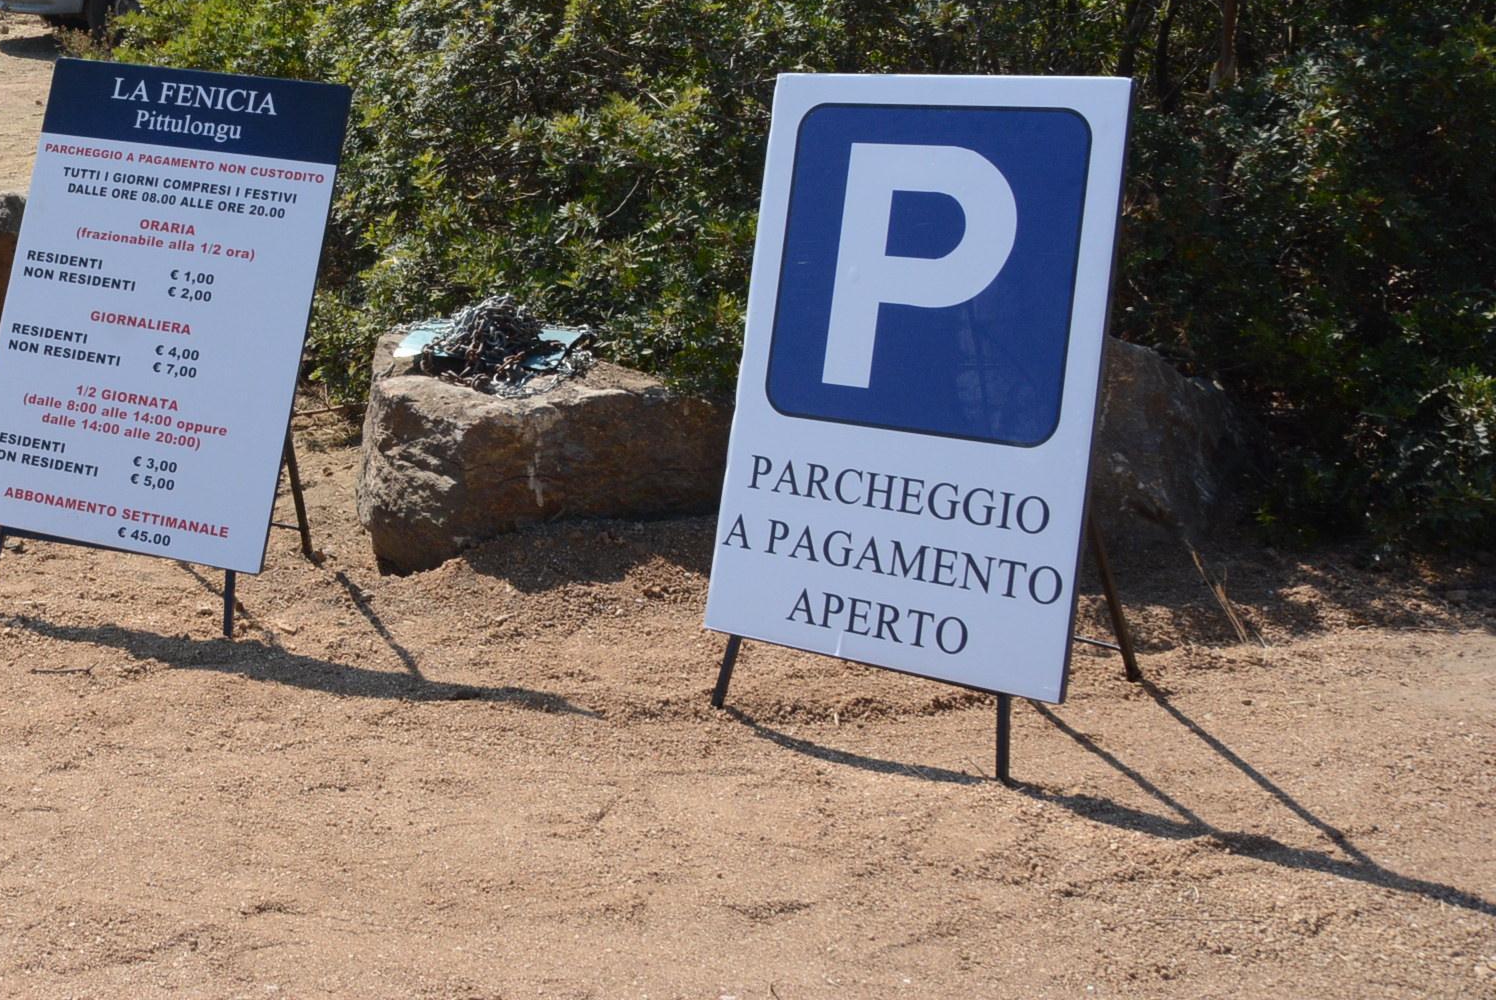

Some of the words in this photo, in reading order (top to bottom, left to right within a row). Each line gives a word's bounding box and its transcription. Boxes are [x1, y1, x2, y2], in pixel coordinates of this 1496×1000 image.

[111, 77, 150, 103] LA
[157, 81, 277, 116] FENICIA
[133, 109, 242, 143] Pittulongu
[44, 143, 123, 161] PARCHEGGIO
[125, 152, 135, 162] A
[138, 153, 215, 171] PAGAMENTO
[218, 162, 247, 175] NON
[250, 166, 325, 184] CUSTODITO
[63, 166, 101, 181] TUTTI
[104, 171, 110, 182] I
[112, 172, 159, 188] GIORNI
[162, 178, 232, 197] COMPRESI
[235, 186, 241, 198] I
[244, 187, 298, 205] FESTIVI
[67, 182, 108, 198] DALLE
[111, 187, 138, 201] ORE
[141, 191, 177, 206] 08.00
[179, 196, 214, 210] ALLE
[217, 200, 246, 214] ORE
[248, 204, 286, 219] 20.00
[76, 226, 164, 248] (frazionabile
[168, 239, 195, 252] alla
[200, 242, 222, 256] 1/2
[225, 248, 255, 263] ora)
[139, 218, 195, 236] ORARIA
[23, 265, 55, 281] NON
[58, 270, 136, 292] RESIDENTI
[167, 286, 177, 298] €
[180, 287, 212, 303] 2,00
[26, 249, 103, 270] RESIDENTI
[169, 269, 180, 281] €
[184, 271, 215, 285] 1,00
[822, 143, 1017, 388] P
[11, 322, 88, 345] RESIDENTI
[154, 344, 165, 356] €
[167, 346, 200, 361] 4,00
[90, 310, 191, 336] GIORNALIERA
[8, 339, 40, 354] NON
[43, 344, 121, 367] RESIDENTI
[152, 361, 162, 373] €
[166, 363, 197, 379] 7,00
[23, 392, 63, 409] (dalle
[66, 399, 97, 415] 8:00
[100, 406, 128, 420] alle
[133, 410, 173, 427] 14:00
[176, 420, 228, 437] oppure
[76, 384, 97, 399] 1/2
[101, 388, 179, 412] GIORNATA
[41, 412, 77, 428] dalle
[81, 418, 120, 435] 14:00
[123, 427, 151, 441] alle
[154, 430, 201, 452] 20:00)
[20, 453, 99, 478] RESIDENTI
[130, 473, 140, 485] €
[143, 475, 175, 491] 5,00
[132, 455, 143, 468] €
[145, 457, 178, 474] 3,00
[3, 486, 117, 517] ABBONAMENTO
[121, 508, 230, 539] SETTIMANALE
[748, 455, 1049, 533] PARCHEGGIO
[117, 526, 127, 539] €
[130, 529, 171, 547] 45.00
[722, 514, 751, 549] A
[764, 520, 1062, 604] PAGAMENTO
[786, 590, 968, 654] APERTO
